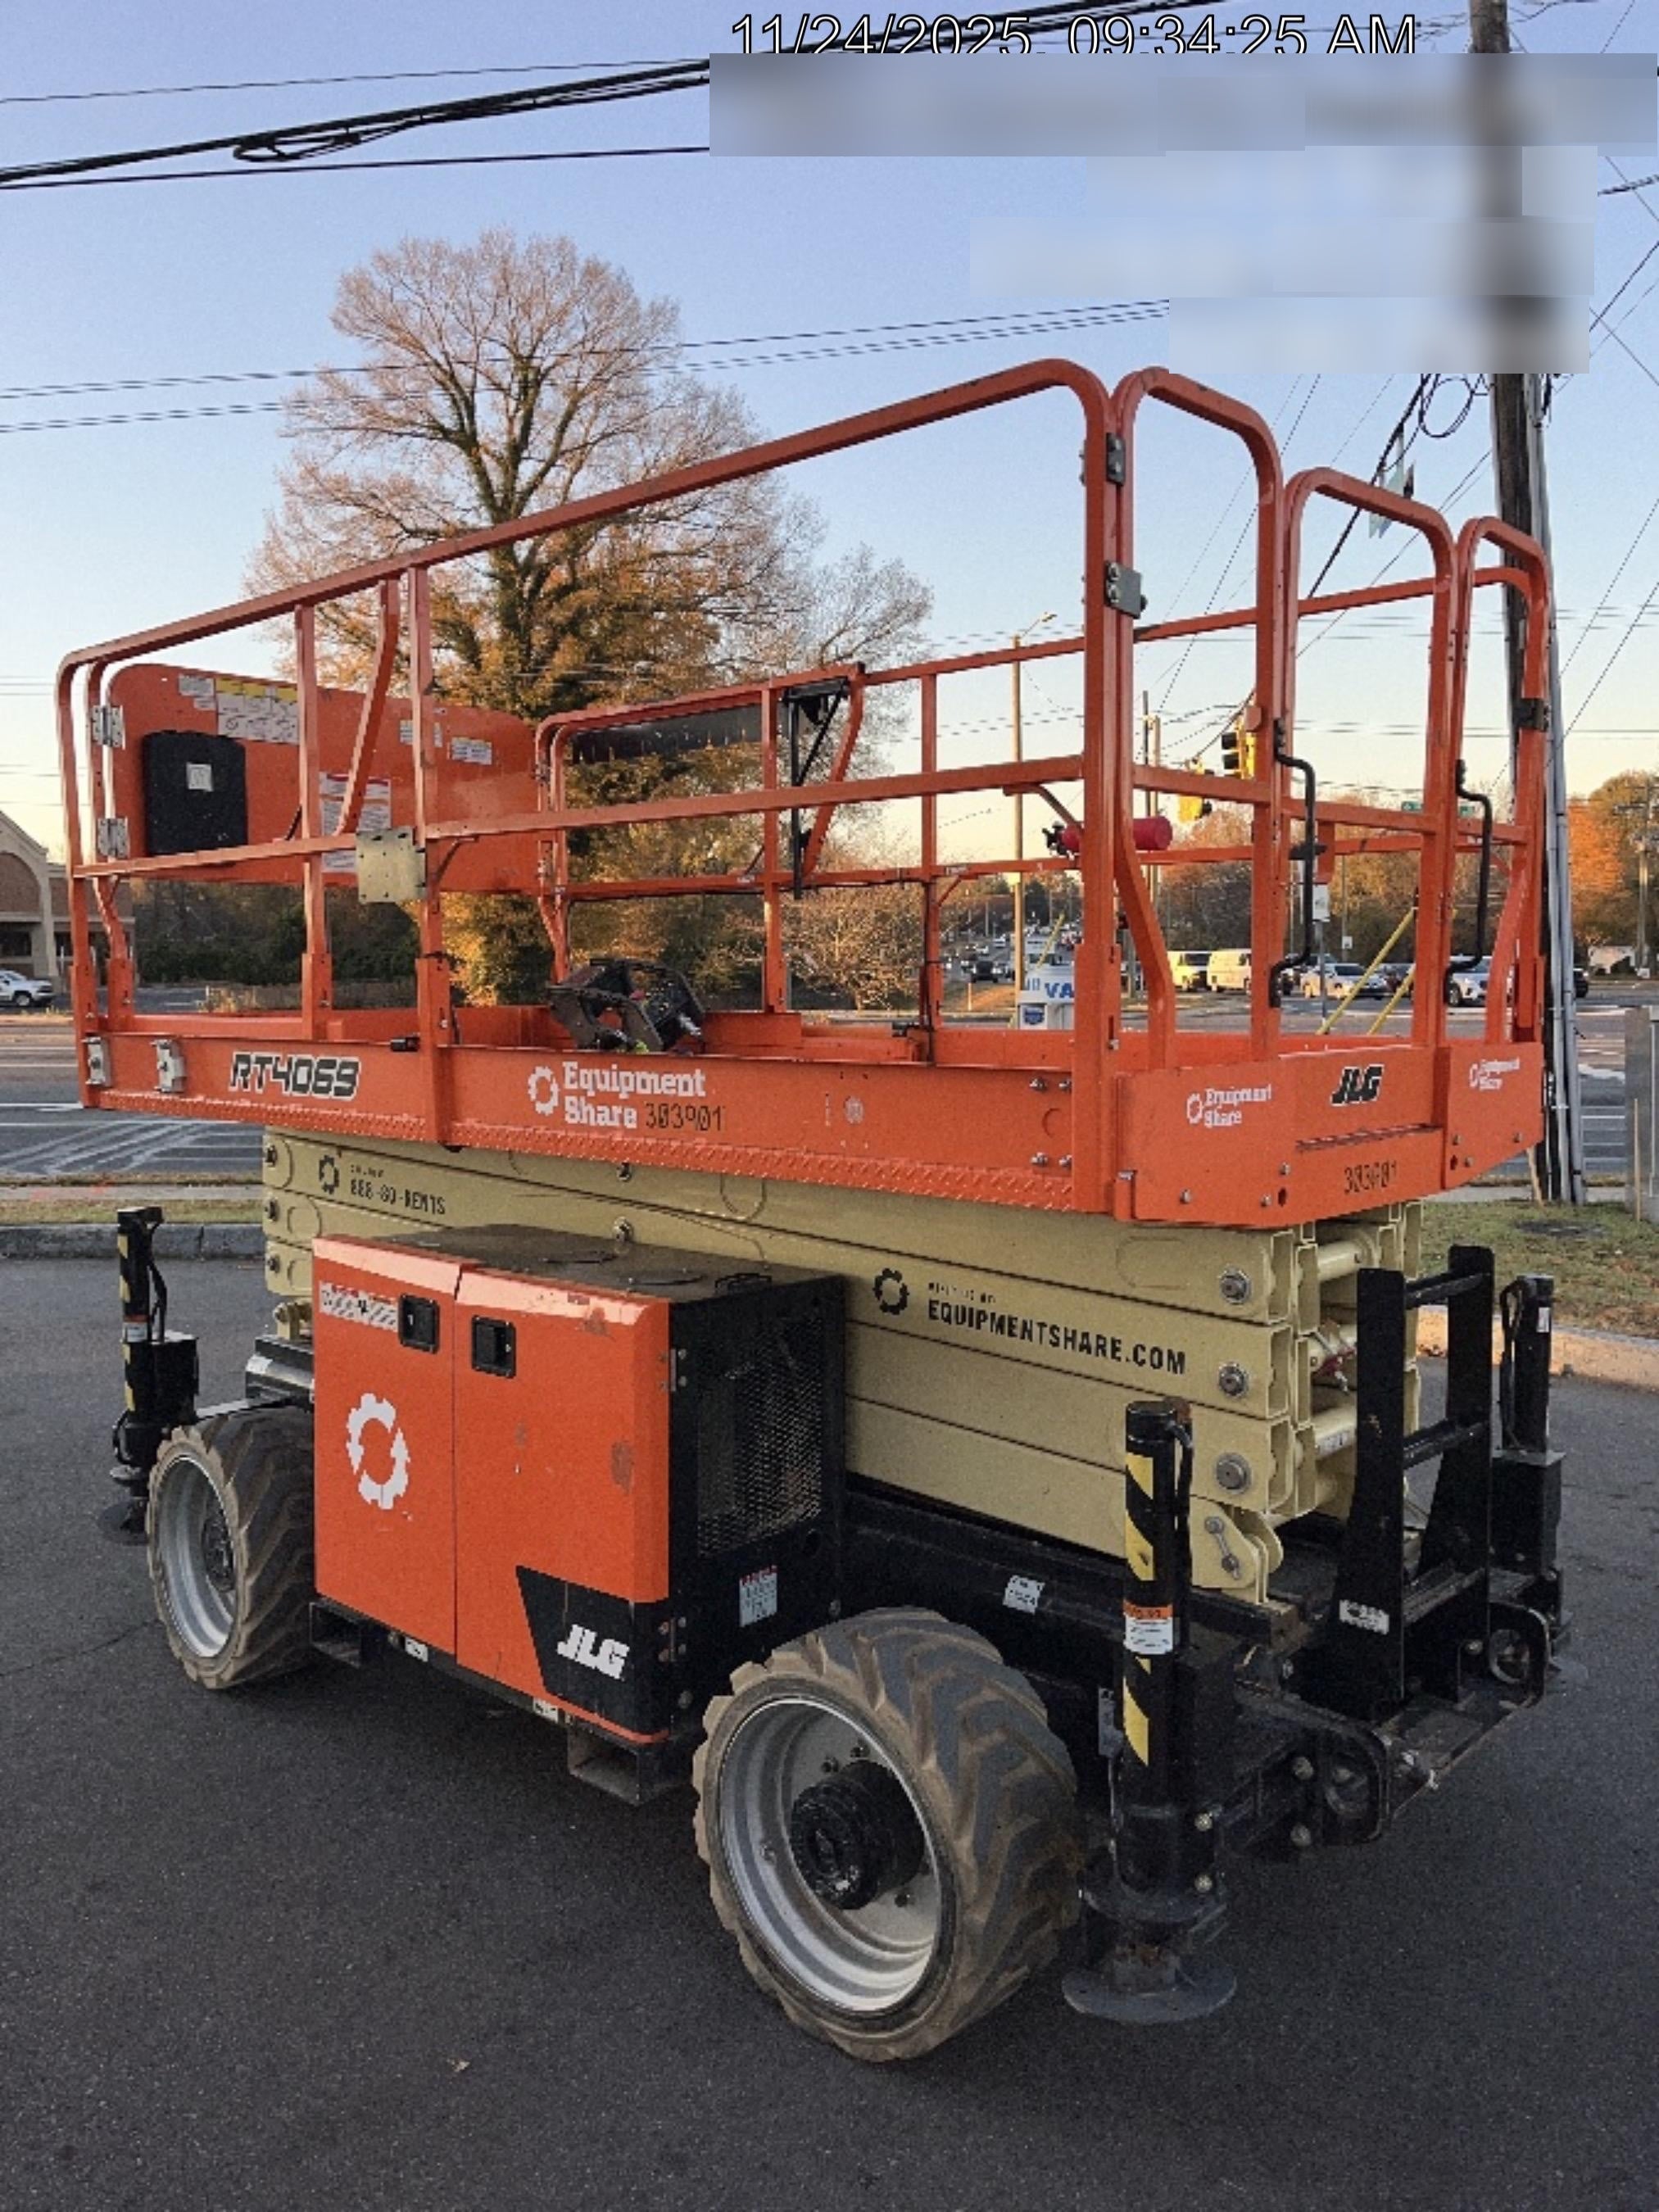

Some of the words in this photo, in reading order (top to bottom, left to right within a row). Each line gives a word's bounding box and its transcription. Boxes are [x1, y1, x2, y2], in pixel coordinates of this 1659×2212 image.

[229, 1052, 361, 1099] RT4069
[563, 1062, 706, 1099] Equipment
[1330, 1063, 1385, 1107] JLG
[564, 1096, 637, 1128] Share
[927, 1299, 1185, 1376] EQUIPMENTSHARE.COM
[557, 1624, 629, 1680] JLG
